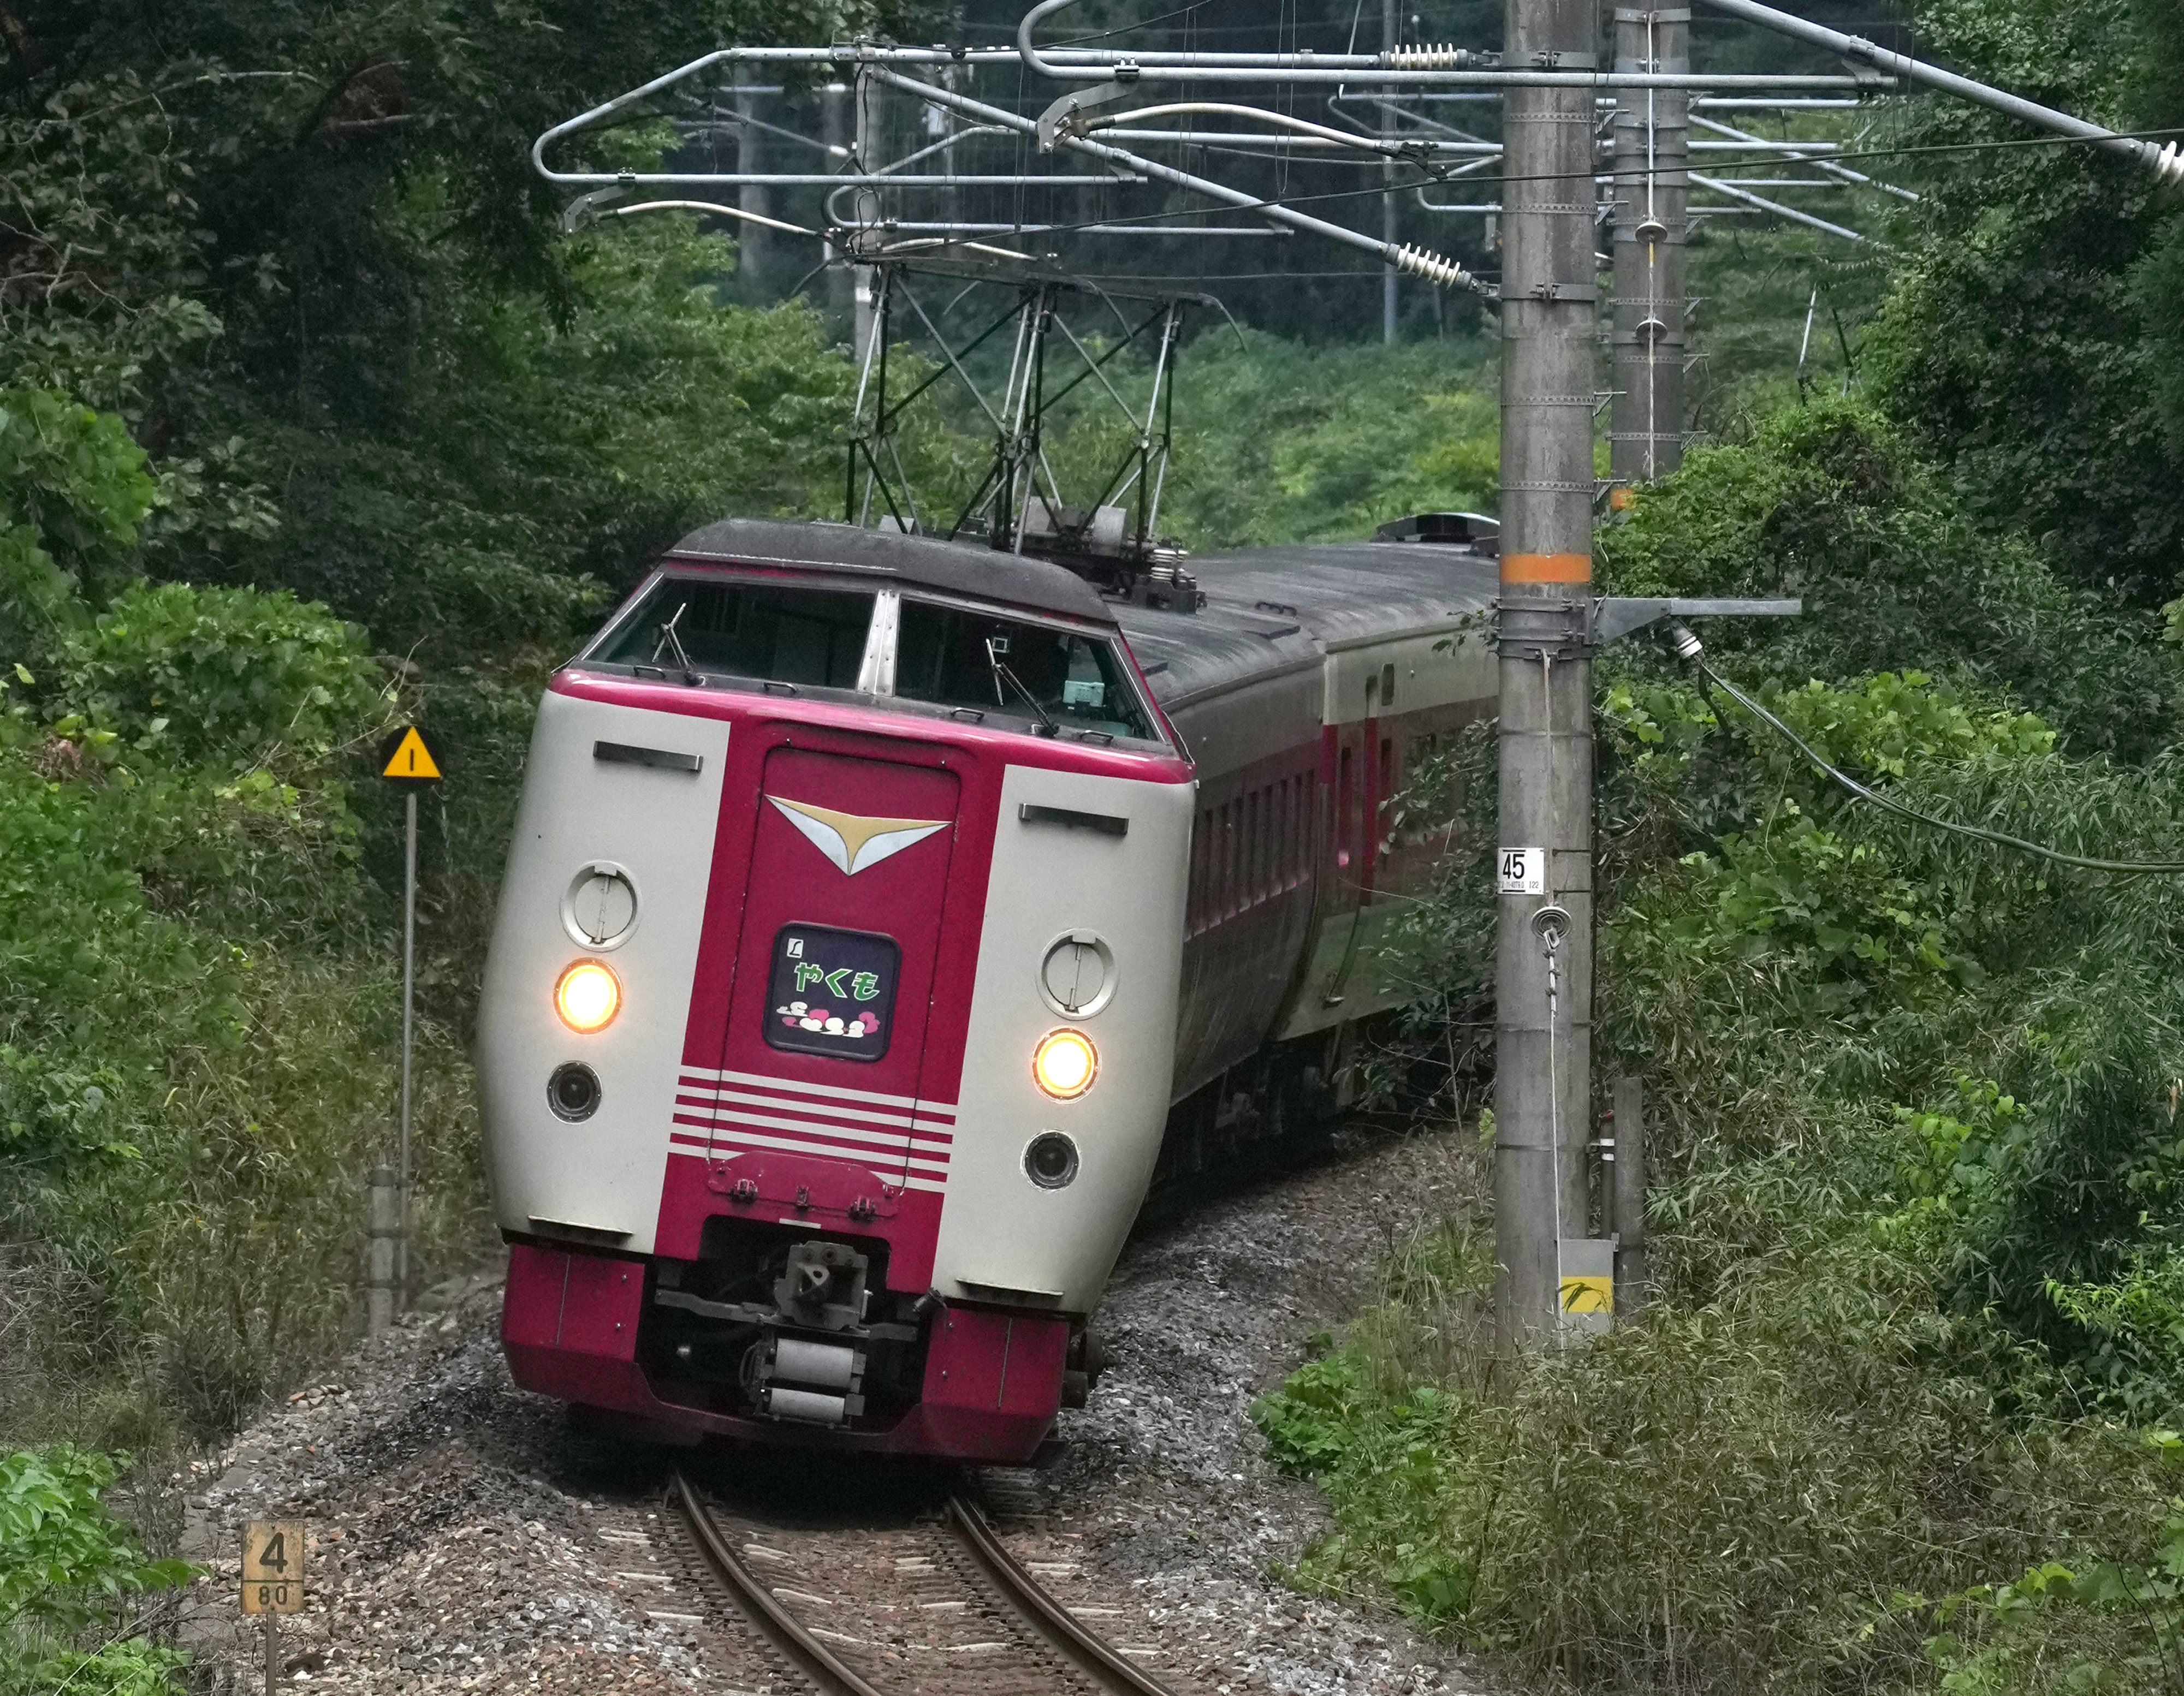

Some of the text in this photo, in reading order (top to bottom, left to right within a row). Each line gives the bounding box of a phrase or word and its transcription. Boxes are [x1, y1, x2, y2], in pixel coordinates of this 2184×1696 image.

[1503, 854, 1525, 879] 45
[794, 962, 880, 1001] やくも
[259, 1532, 288, 1574] 4
[259, 1586, 287, 1605] 80
